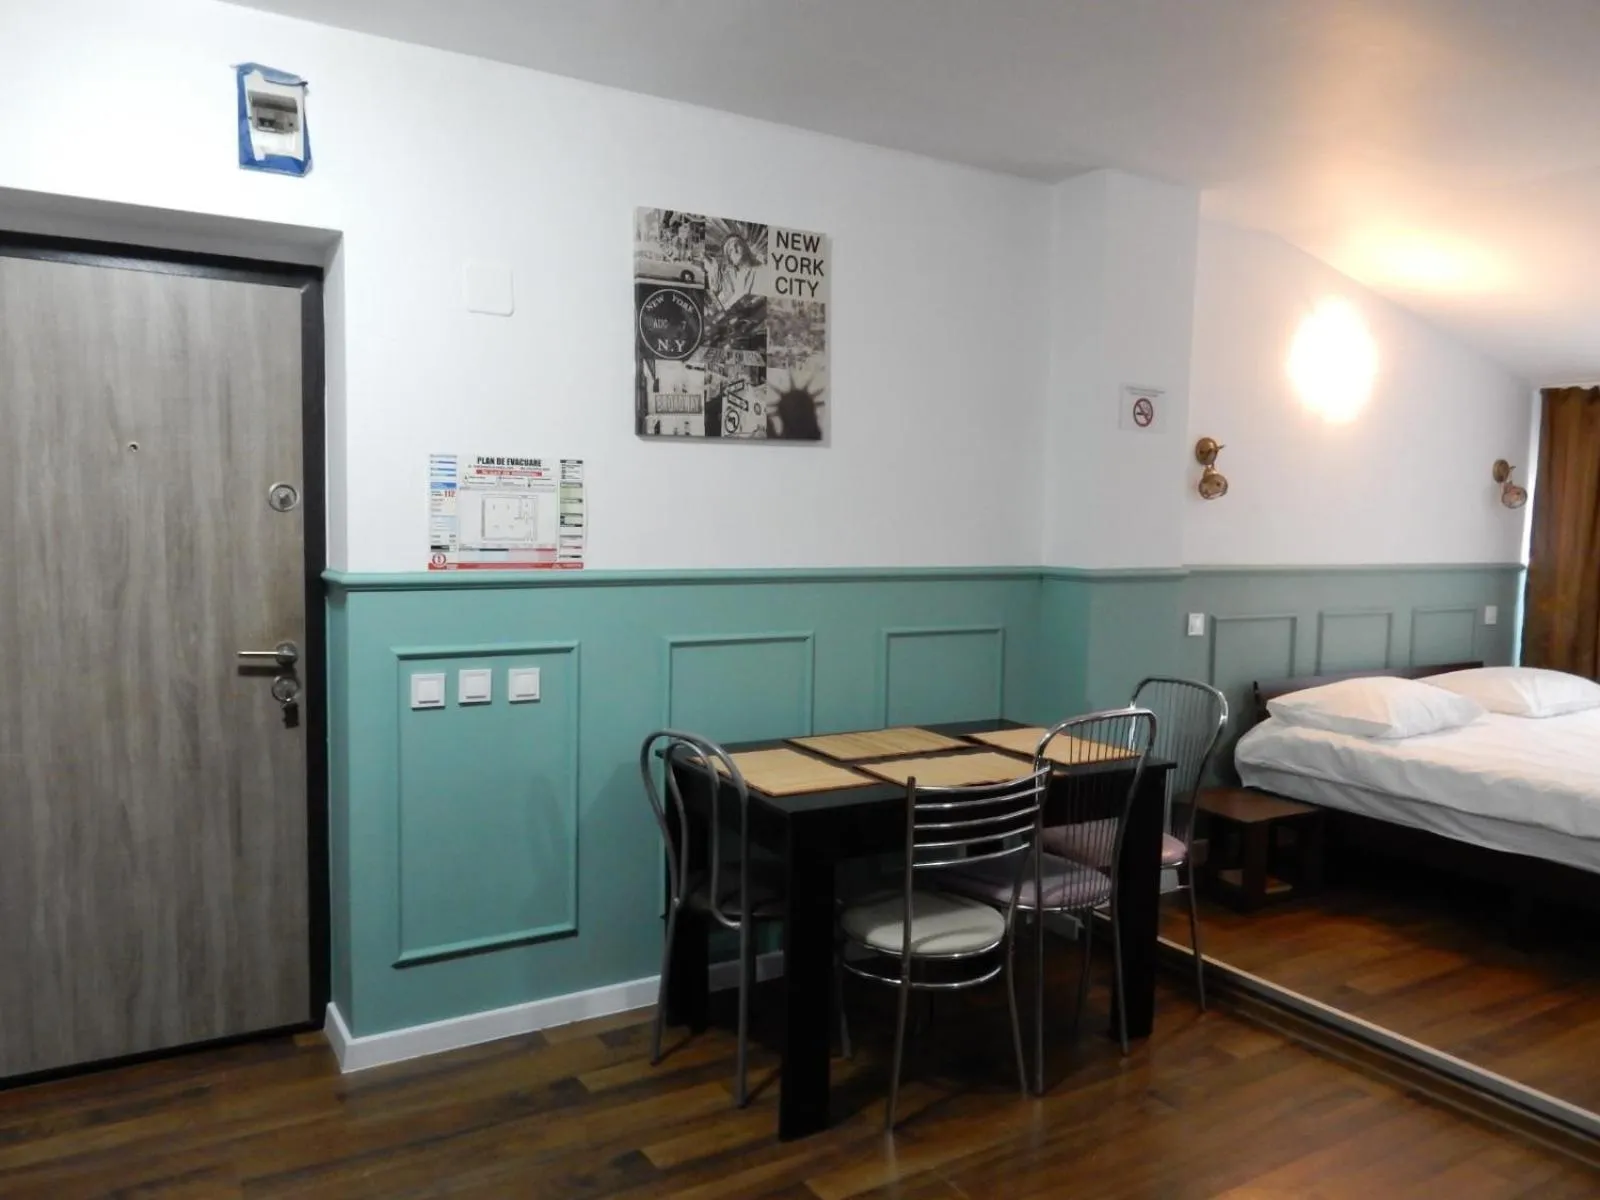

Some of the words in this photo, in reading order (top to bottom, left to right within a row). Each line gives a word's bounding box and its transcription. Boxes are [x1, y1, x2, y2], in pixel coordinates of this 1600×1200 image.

[776, 231, 820, 253] NEW
[772, 254, 825, 277] YORK
[775, 276, 819, 298] CITY
[645, 294, 664, 311] NEW
[672, 293, 694, 312] YORK
[477, 456, 495, 465] PLAN
[497, 457, 505, 466] DE
[507, 457, 542, 467] EVACUARE
